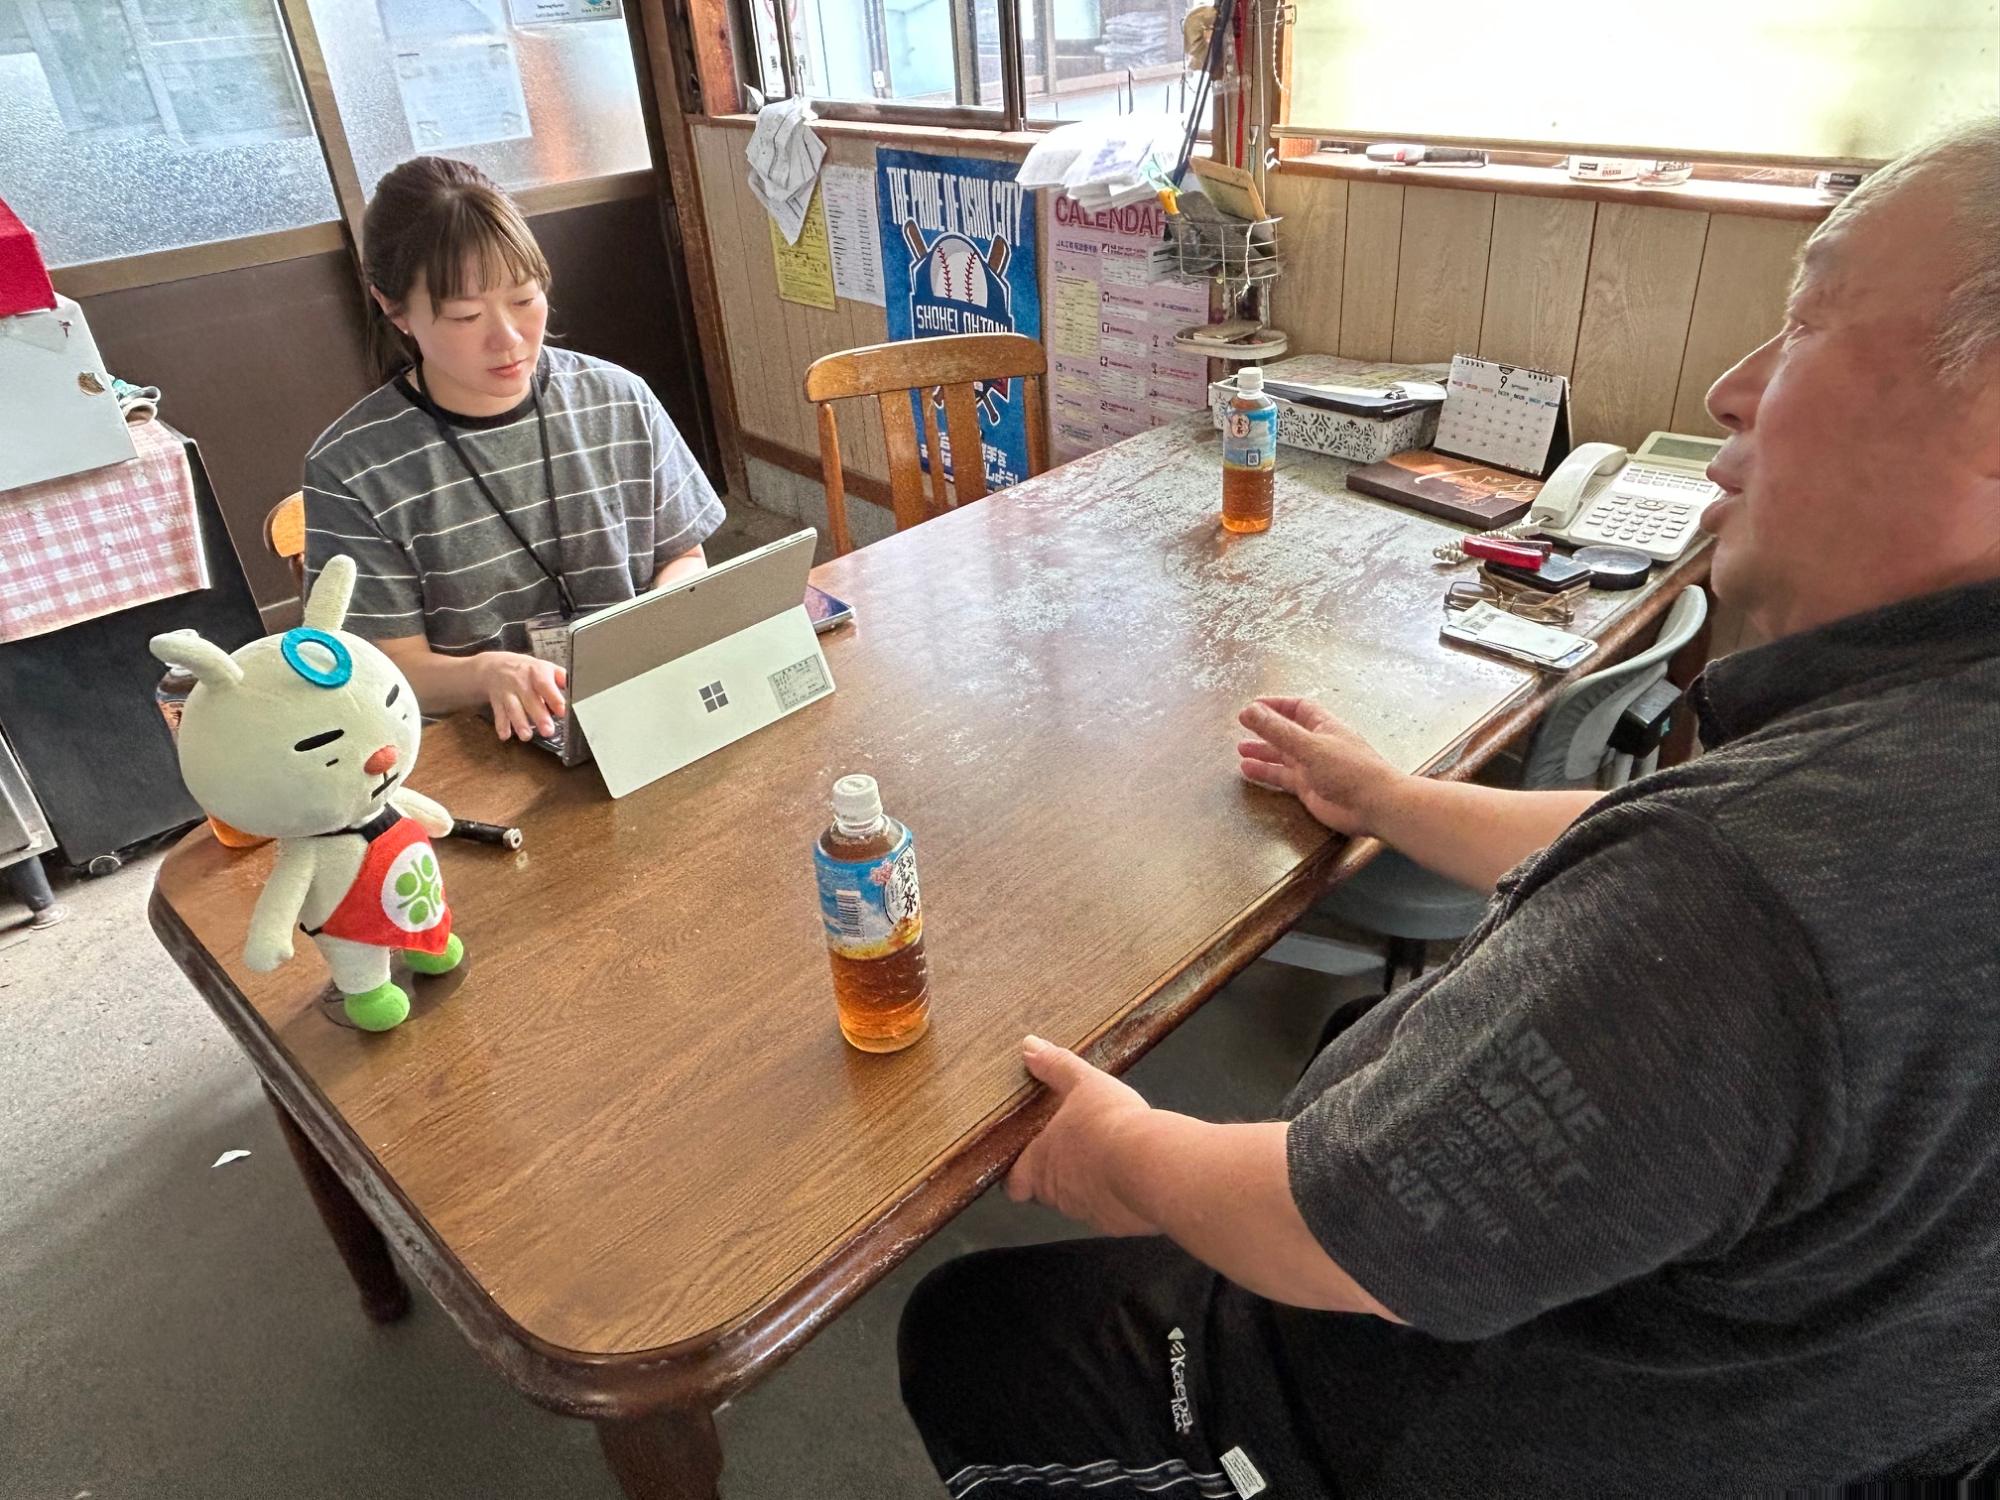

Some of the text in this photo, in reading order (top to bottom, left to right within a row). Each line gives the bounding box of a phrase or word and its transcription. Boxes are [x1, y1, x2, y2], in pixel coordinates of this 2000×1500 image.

[886, 166, 910, 225] THE
[909, 168, 945, 232] PRIDE
[943, 173, 959, 232] OF
[958, 176, 992, 241] OSHU
[991, 180, 1023, 247] CITY
[916, 304, 1008, 333] SHOHEI OHTA
[1500, 375, 1508, 389] 9
